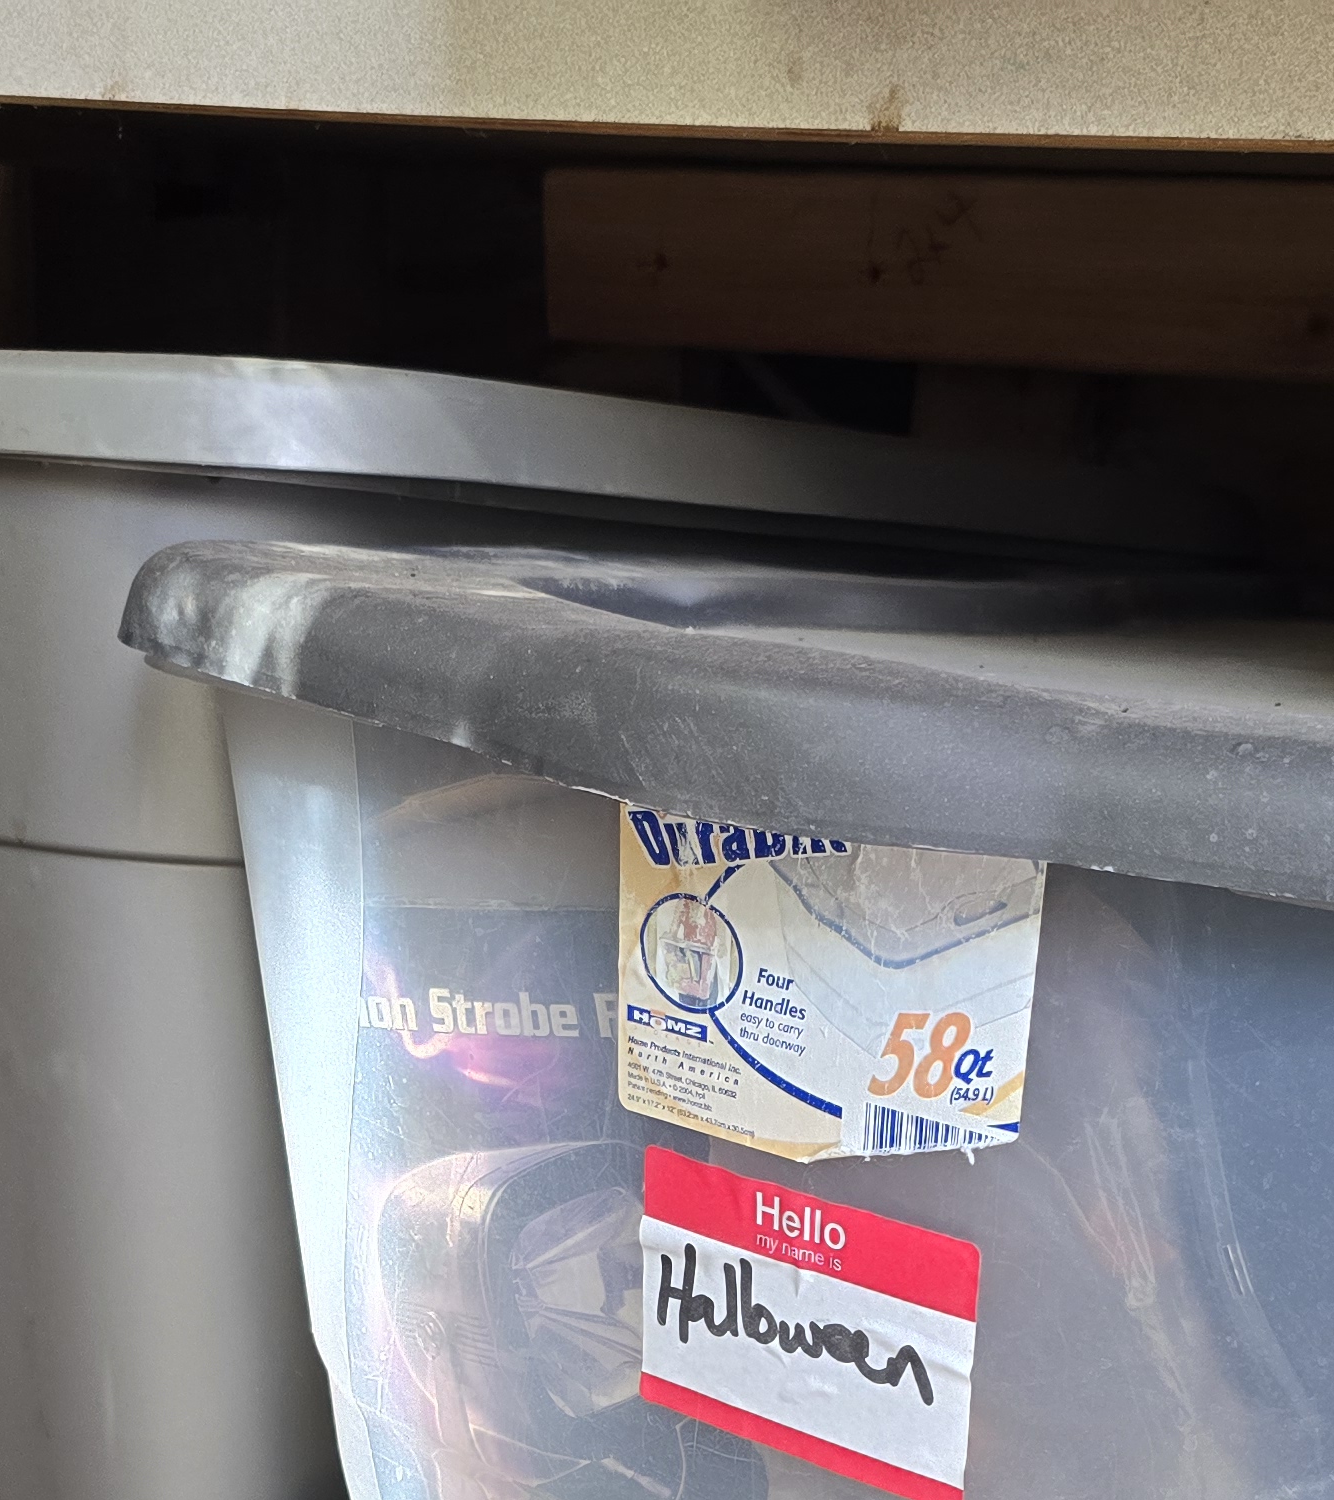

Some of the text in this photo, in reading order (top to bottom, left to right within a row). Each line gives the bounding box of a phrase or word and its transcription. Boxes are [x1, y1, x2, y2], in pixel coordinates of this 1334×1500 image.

[757, 968, 794, 991] Four
[428, 986, 580, 1038] Strobe
[742, 990, 806, 1020] Handles
[740, 1012, 804, 1039] easy to carry
[649, 1041, 680, 1057] Products
[682, 1050, 727, 1071] International
[739, 1026, 806, 1057] thru doorway
[868, 1012, 994, 1099] 58 Qt
[677, 1062, 739, 1085] America
[950, 1086, 994, 1105] (54.9 L)
[755, 1191, 846, 1250] Hello
[755, 1233, 842, 1271] my name is
[657, 1243, 934, 1406] Halloween
